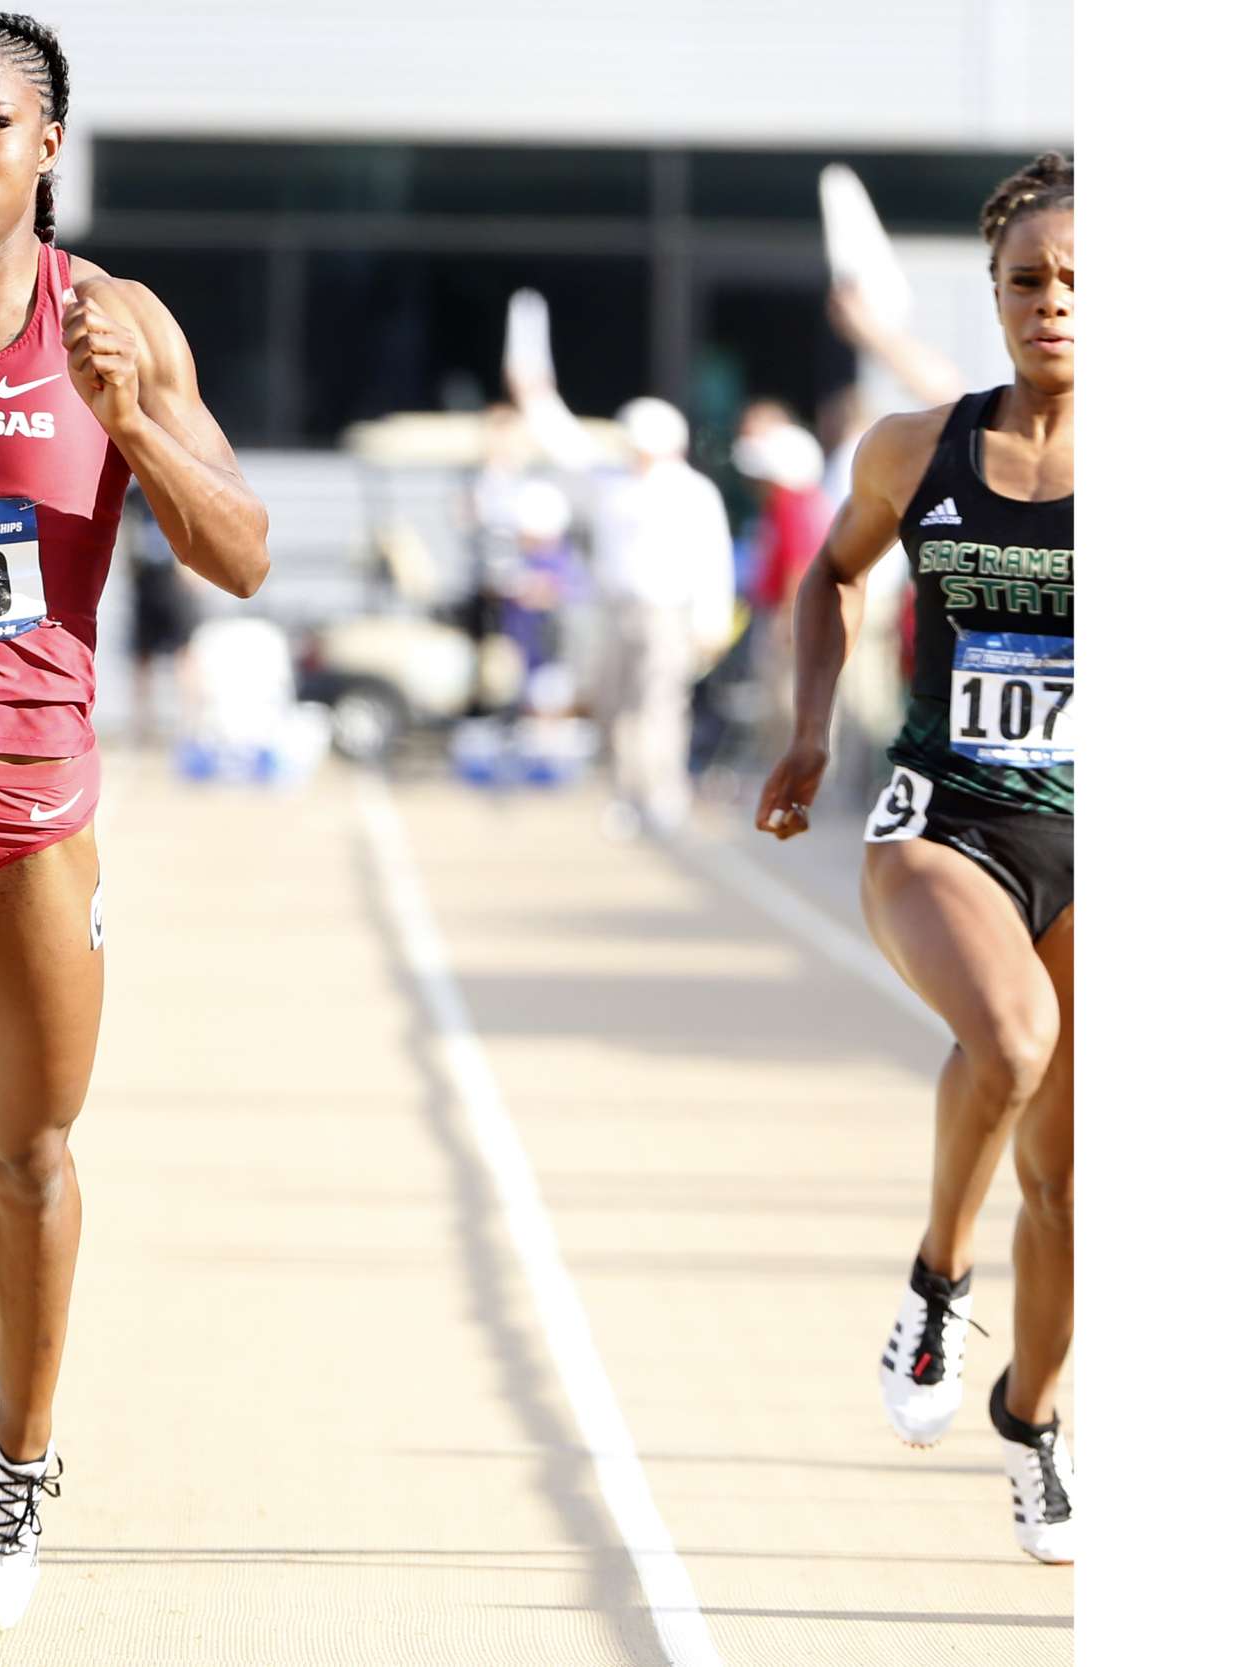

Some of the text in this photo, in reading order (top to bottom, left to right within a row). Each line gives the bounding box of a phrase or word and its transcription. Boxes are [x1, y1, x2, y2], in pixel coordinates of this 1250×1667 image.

[918, 540, 1074, 580] SACRAME
[940, 575, 1074, 617] STAT
[960, 677, 1074, 741] 107
[873, 773, 915, 838] 9
